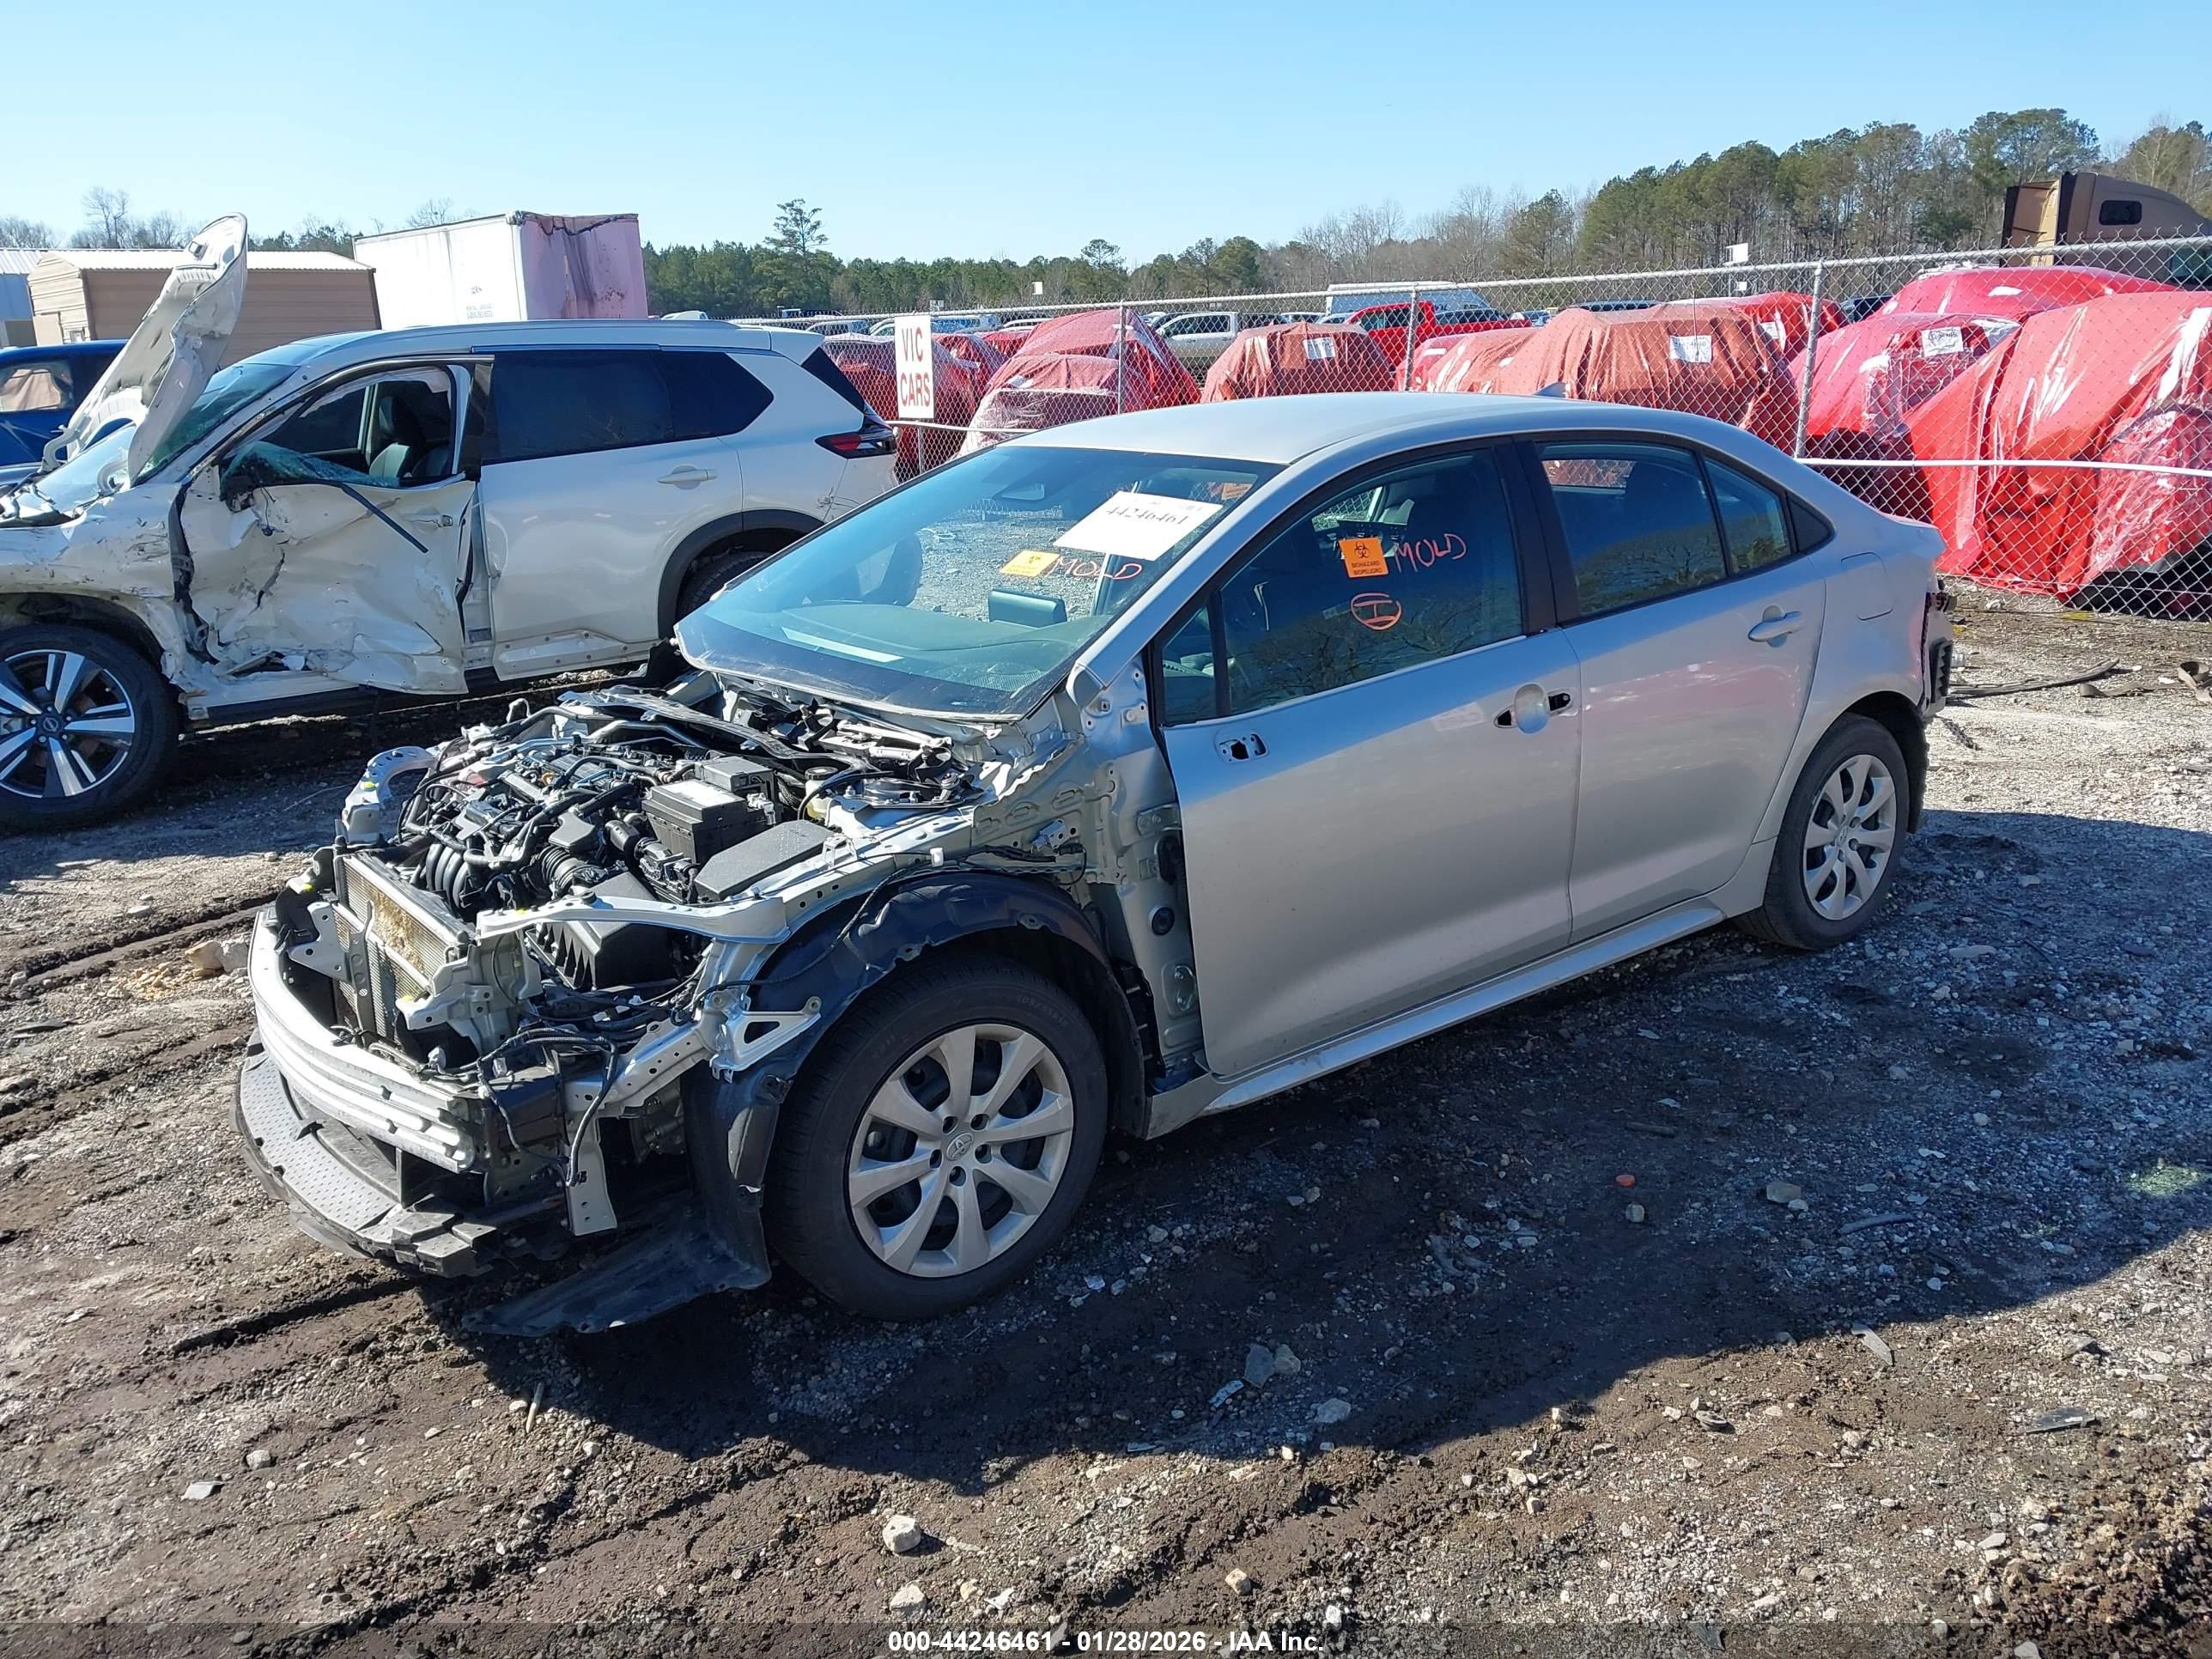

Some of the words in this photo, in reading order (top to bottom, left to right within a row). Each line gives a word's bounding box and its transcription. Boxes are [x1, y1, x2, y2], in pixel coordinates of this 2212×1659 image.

[901, 326, 924, 362] VIC
[900, 372, 931, 408] CARS
[1105, 504, 1189, 526] 44246461
[1046, 555, 1143, 580] MOLD
[1394, 533, 1467, 573] MOLD
